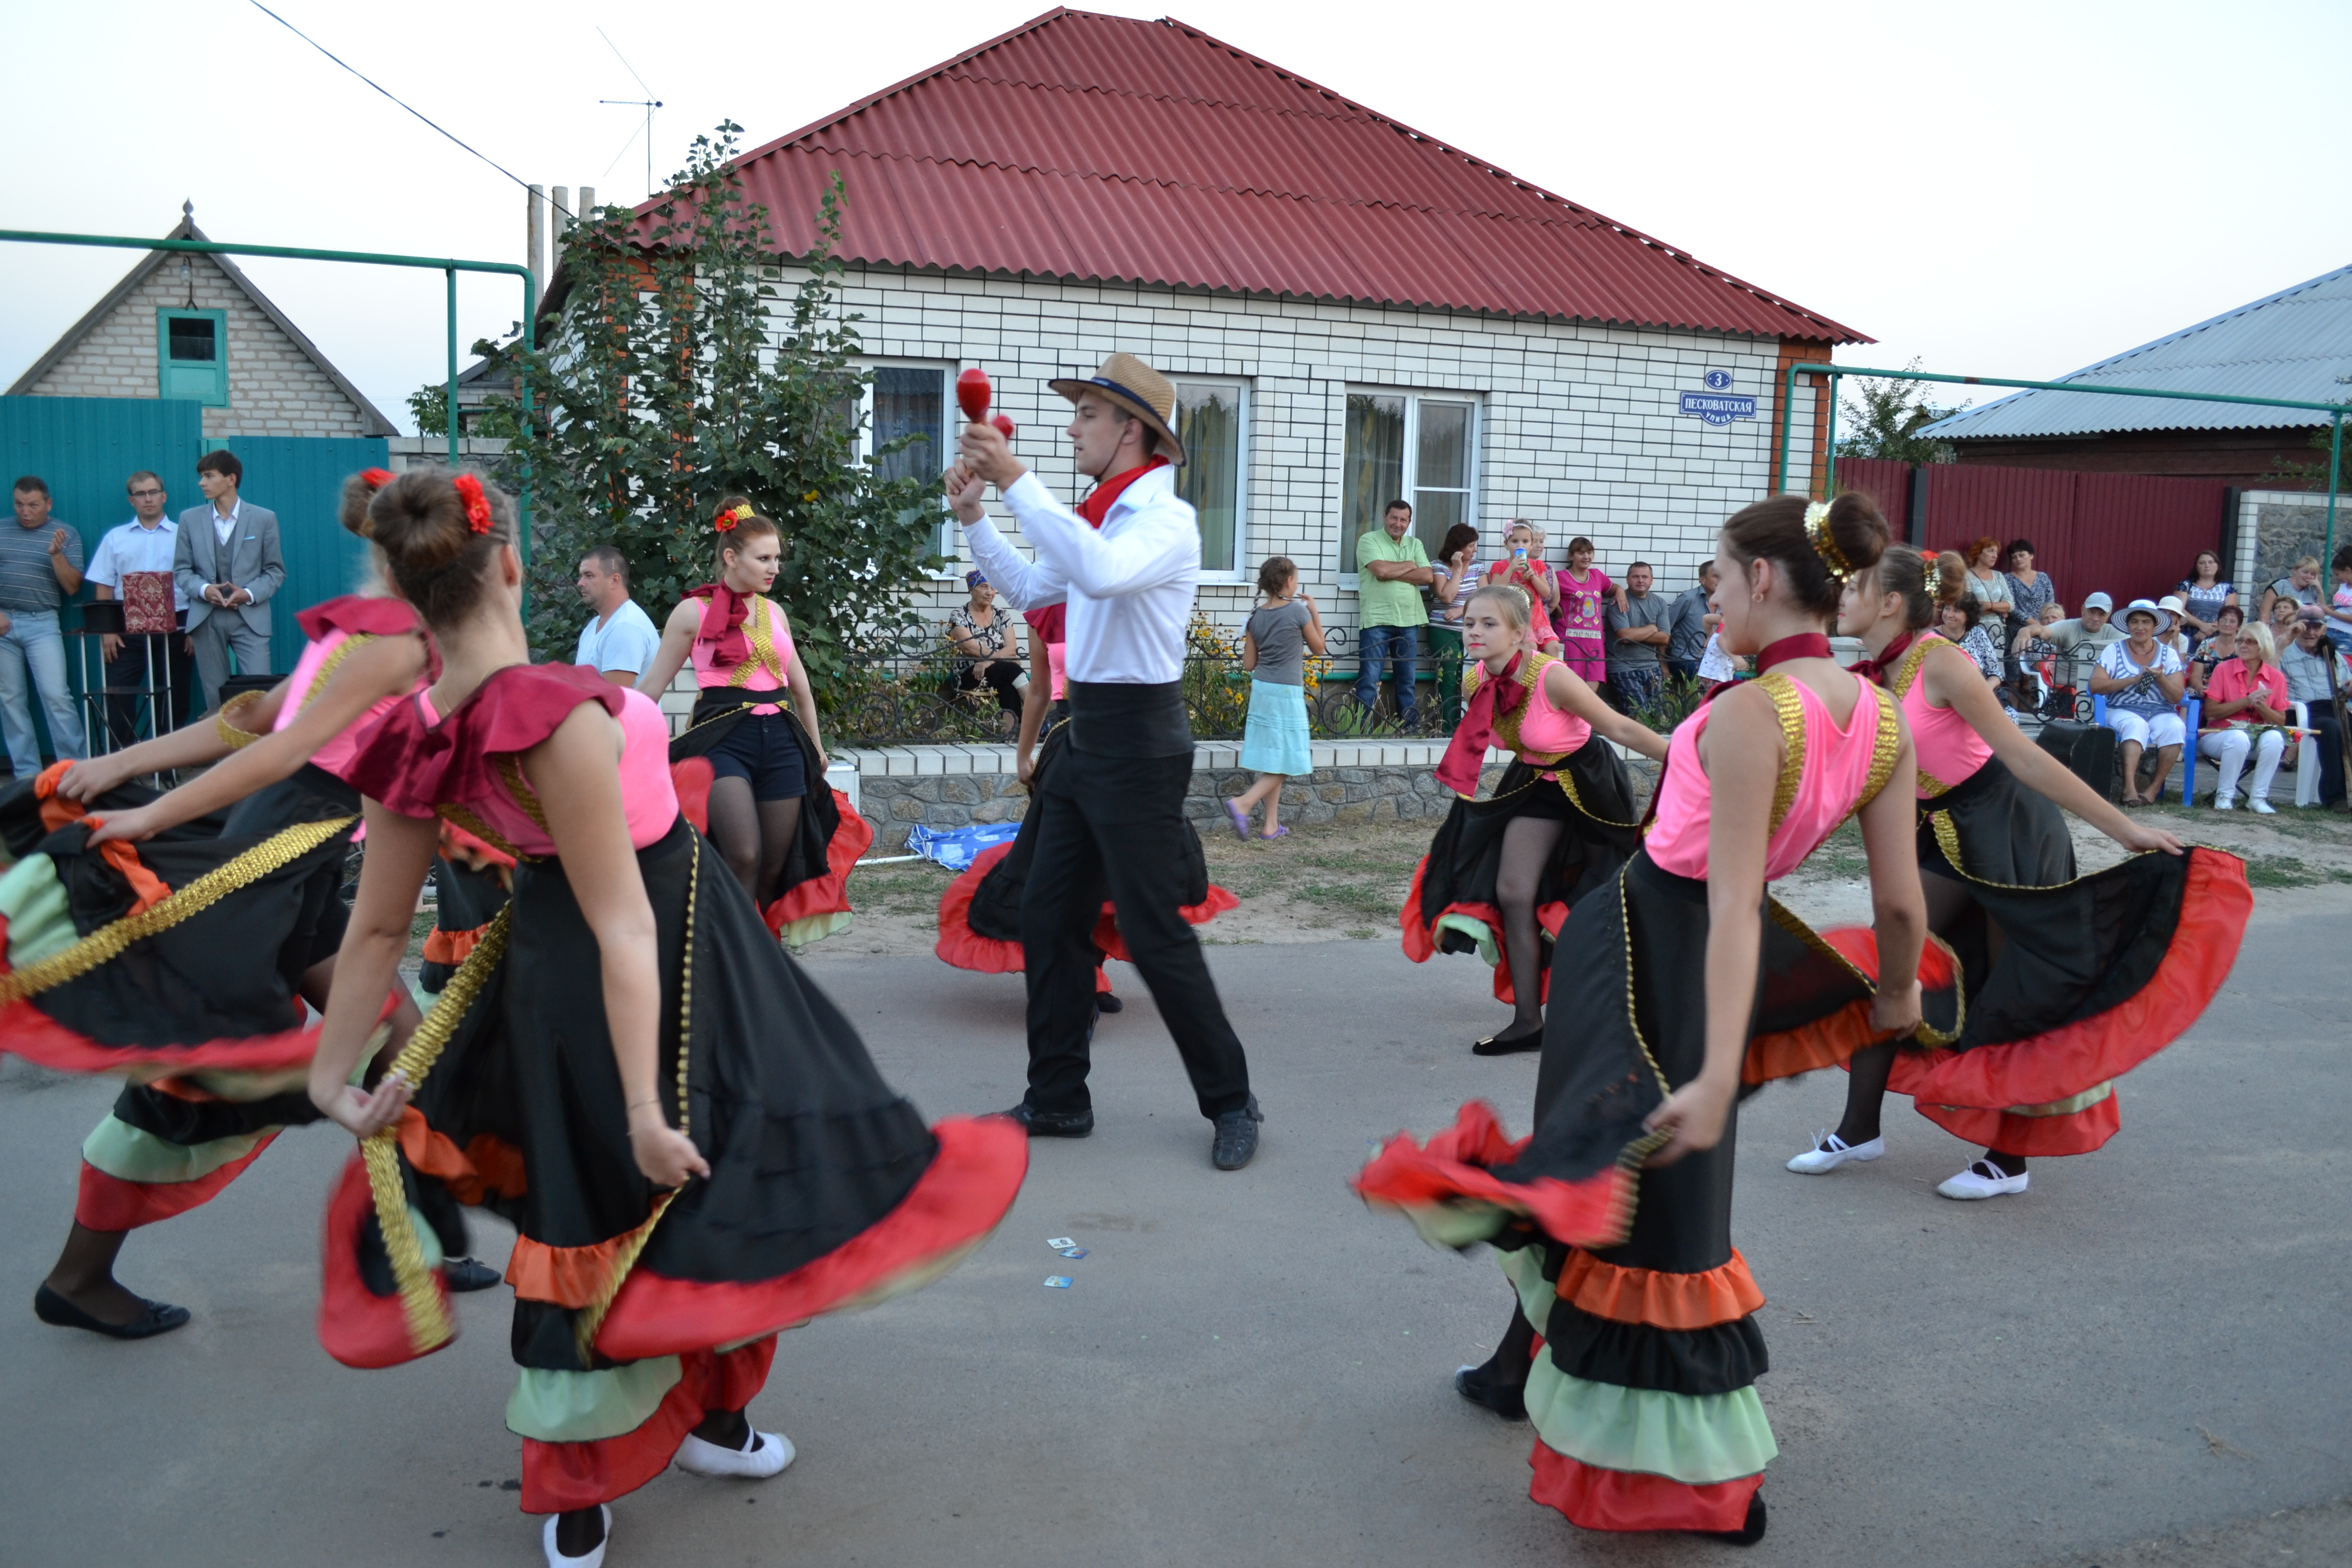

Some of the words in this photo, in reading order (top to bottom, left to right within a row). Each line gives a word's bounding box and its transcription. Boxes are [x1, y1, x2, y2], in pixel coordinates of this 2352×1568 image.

[1715, 373, 1722, 386] 3
[1685, 398, 1752, 412] ПЕСКОВАТСКАЯ
[1705, 411, 1731, 423] УЛИЦА
